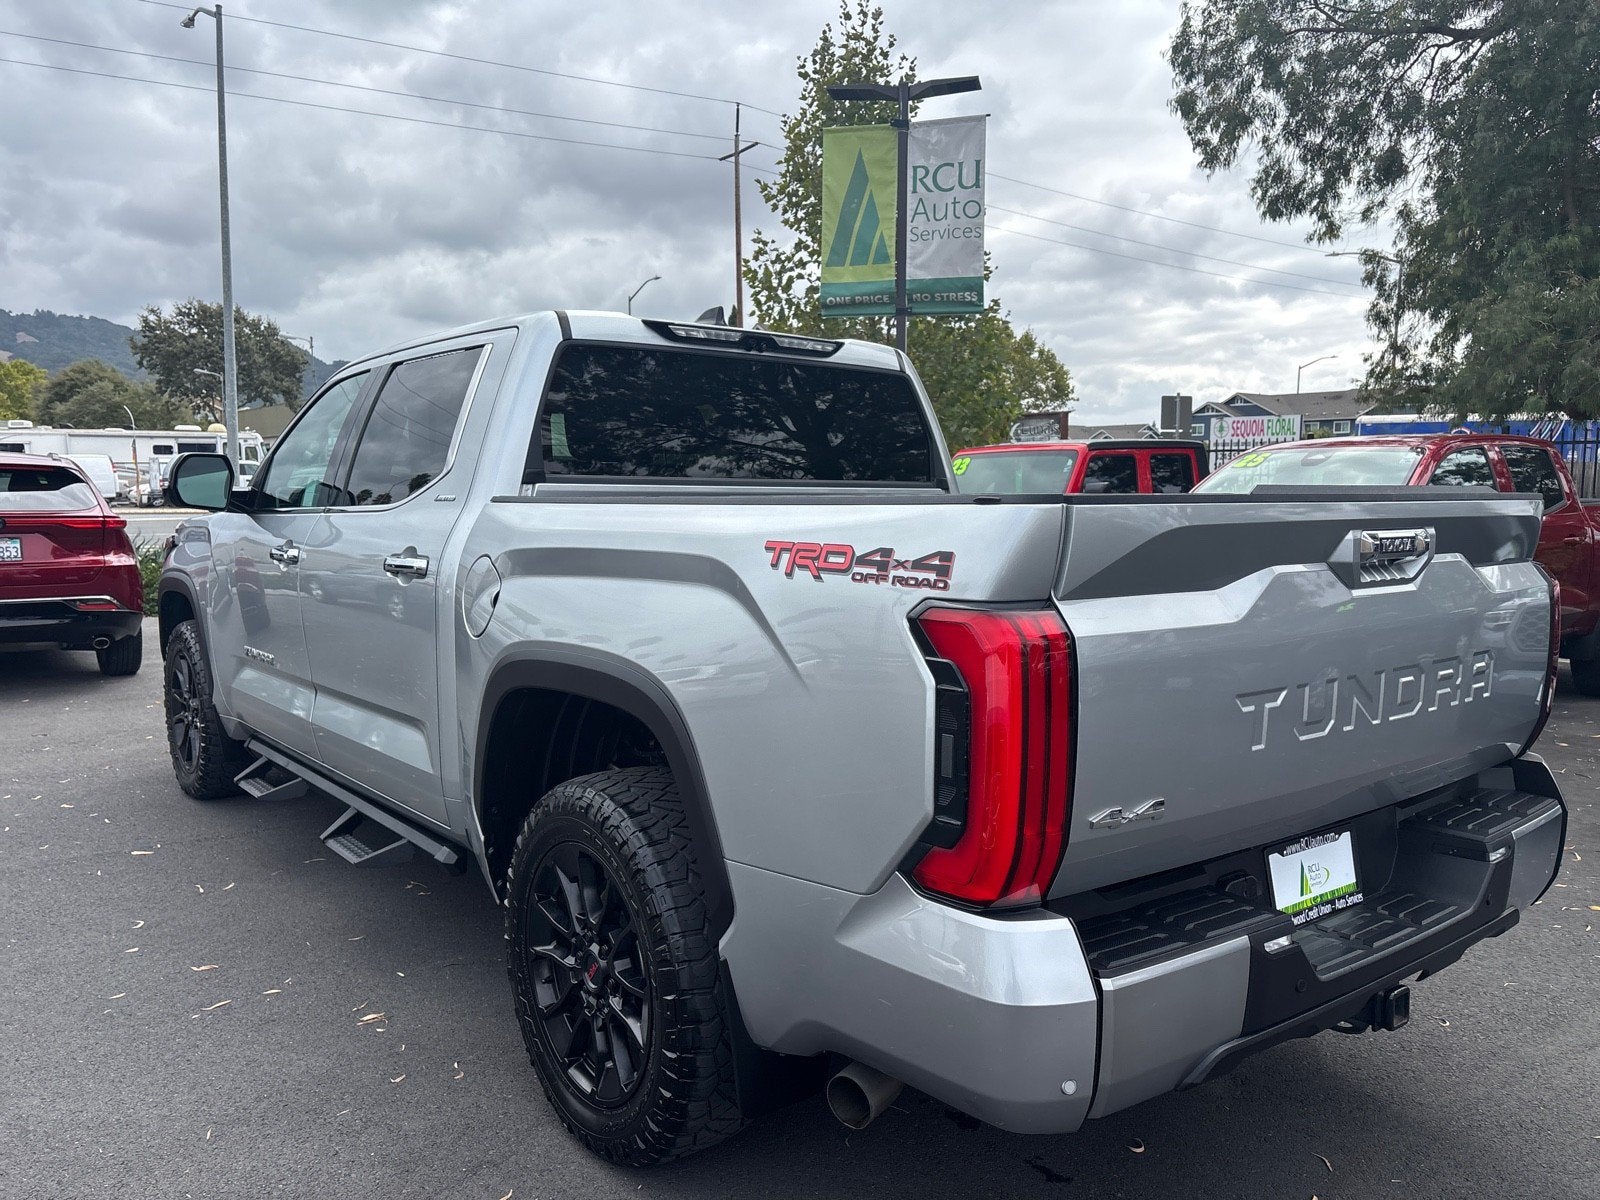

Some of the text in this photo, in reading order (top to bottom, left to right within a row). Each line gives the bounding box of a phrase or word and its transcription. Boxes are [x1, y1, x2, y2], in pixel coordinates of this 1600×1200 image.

[911, 159, 982, 194] RCU
[910, 196, 982, 223] Auto
[909, 224, 982, 242] Services
[826, 291, 978, 306] ONE PRICE NO STRESS
[1231, 417, 1296, 438] SEQUOIA FLORAL
[1381, 538, 1414, 552] TOYOTA
[764, 540, 856, 583] TRD
[850, 571, 952, 592] OFF ROAD
[1235, 649, 1496, 752] TUNDRA
[1307, 862, 1320, 874] RCU
[1305, 906, 1320, 921] Credit
[1318, 902, 1333, 916] Union
[1335, 898, 1347, 910] Auto
[1345, 892, 1364, 907] Services
